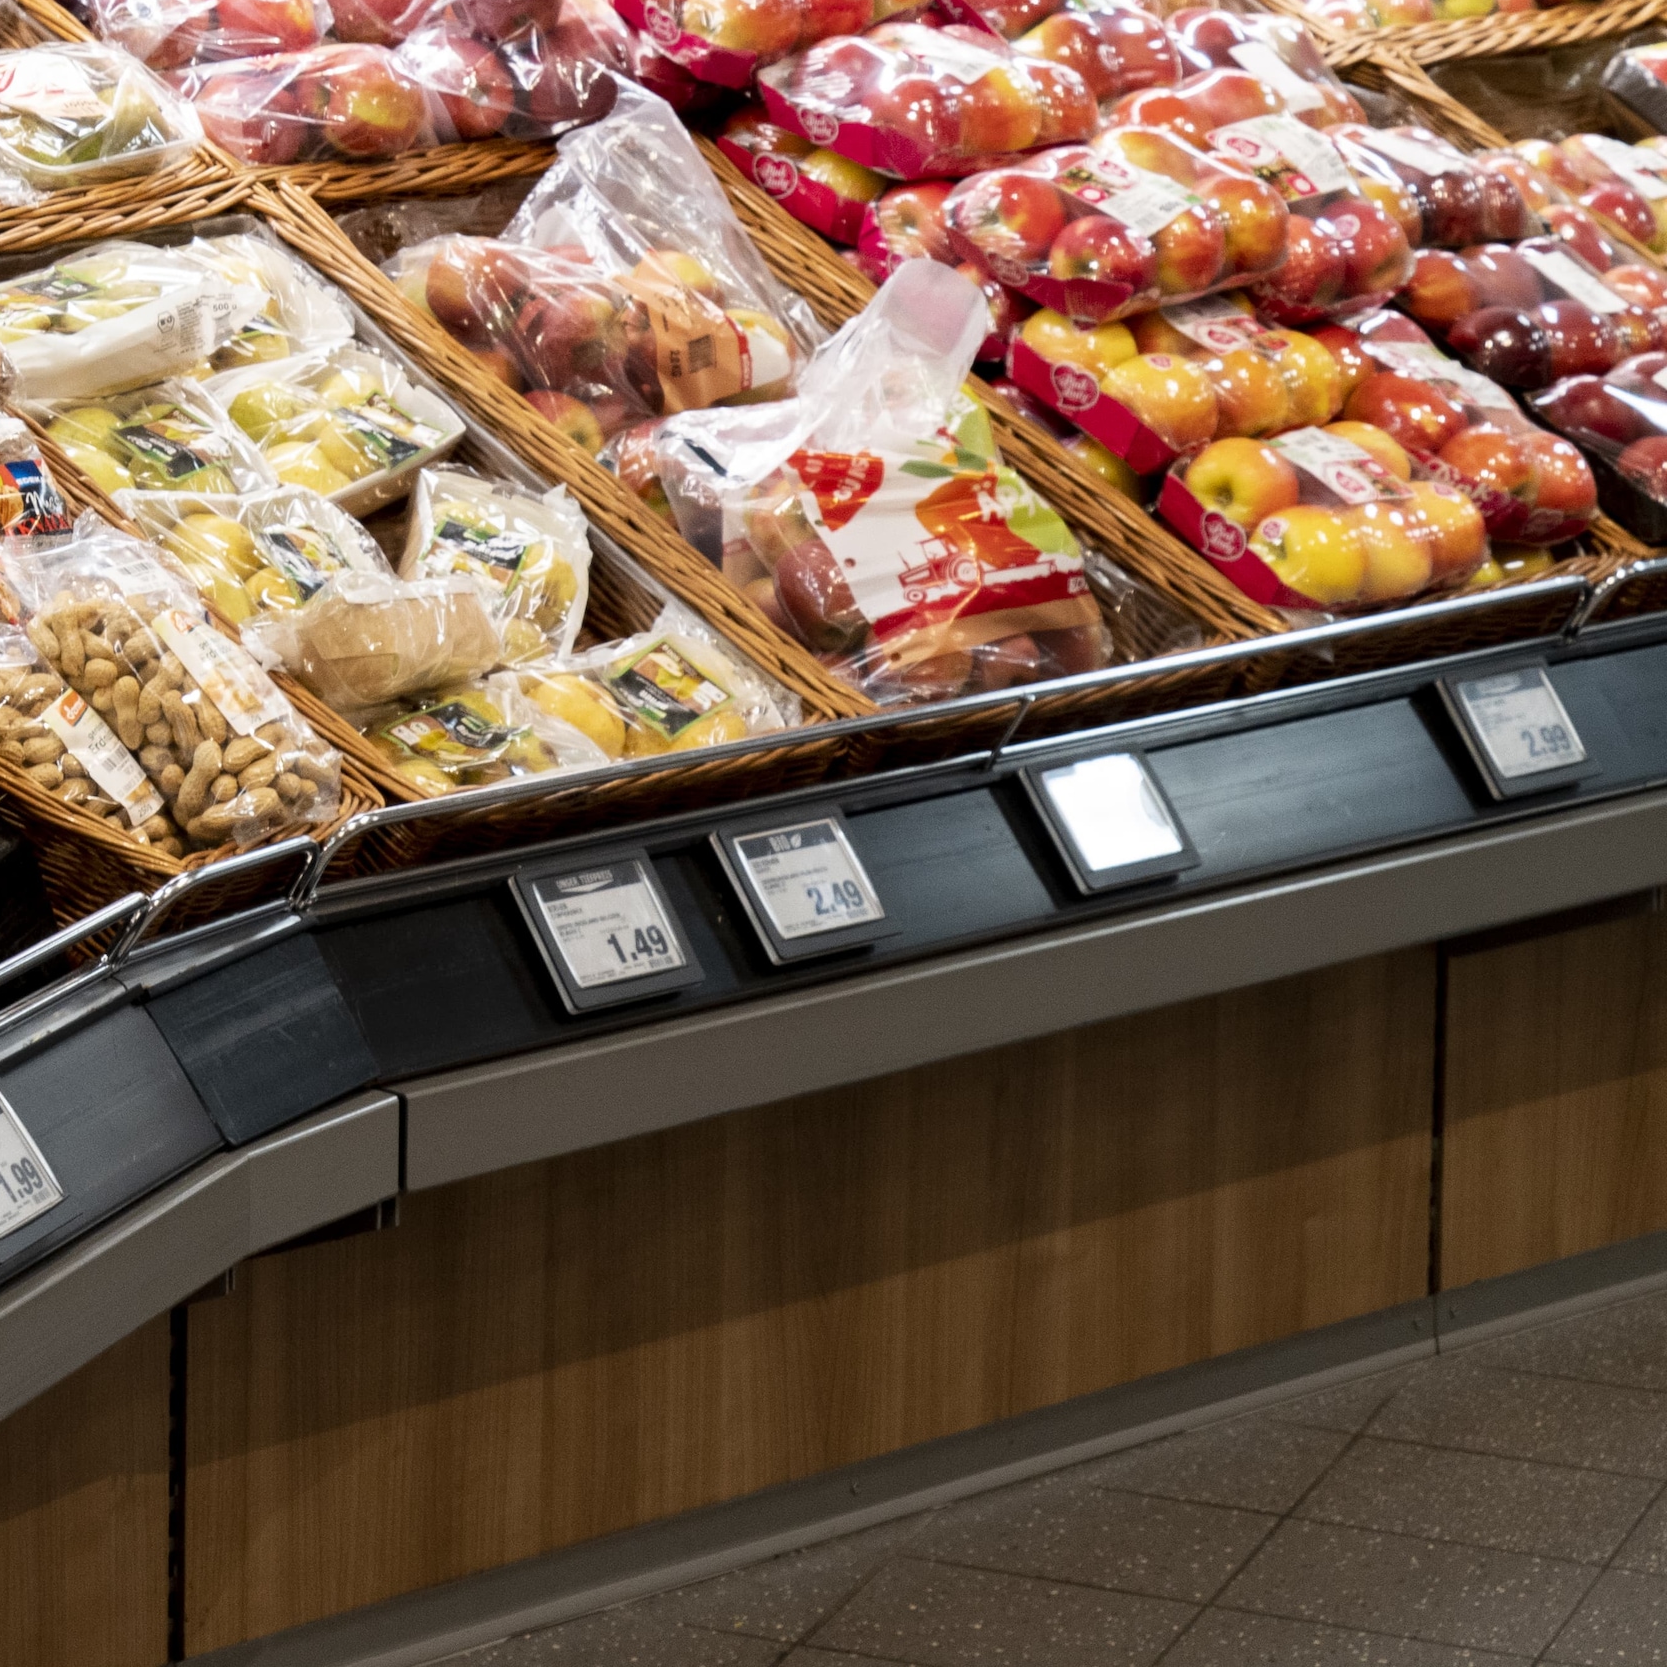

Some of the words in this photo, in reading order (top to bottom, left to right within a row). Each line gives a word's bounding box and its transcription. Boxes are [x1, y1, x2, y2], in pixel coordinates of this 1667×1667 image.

[1520, 723, 1573, 757] 2.99
[768, 833, 789, 852] BIO
[806, 878, 864, 917] 2.49
[606, 923, 669, 965] 1.49
